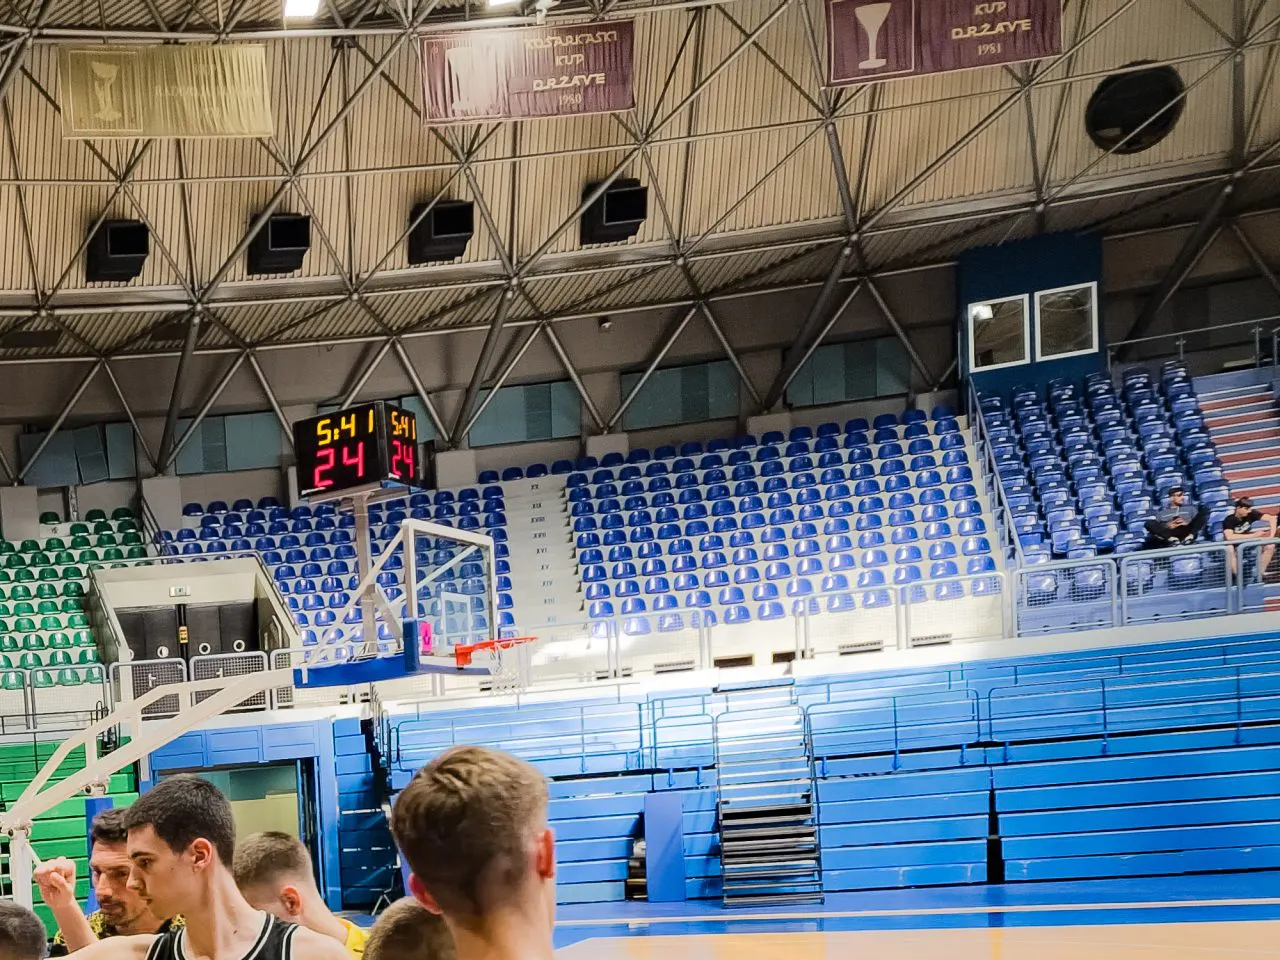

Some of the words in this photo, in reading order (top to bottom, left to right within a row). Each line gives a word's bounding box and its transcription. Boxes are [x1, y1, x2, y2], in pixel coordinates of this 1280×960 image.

[975, 1, 1007, 16] KUP
[555, 53, 584, 66] KUP
[314, 441, 365, 487] 24
[392, 440, 414, 478] 24
